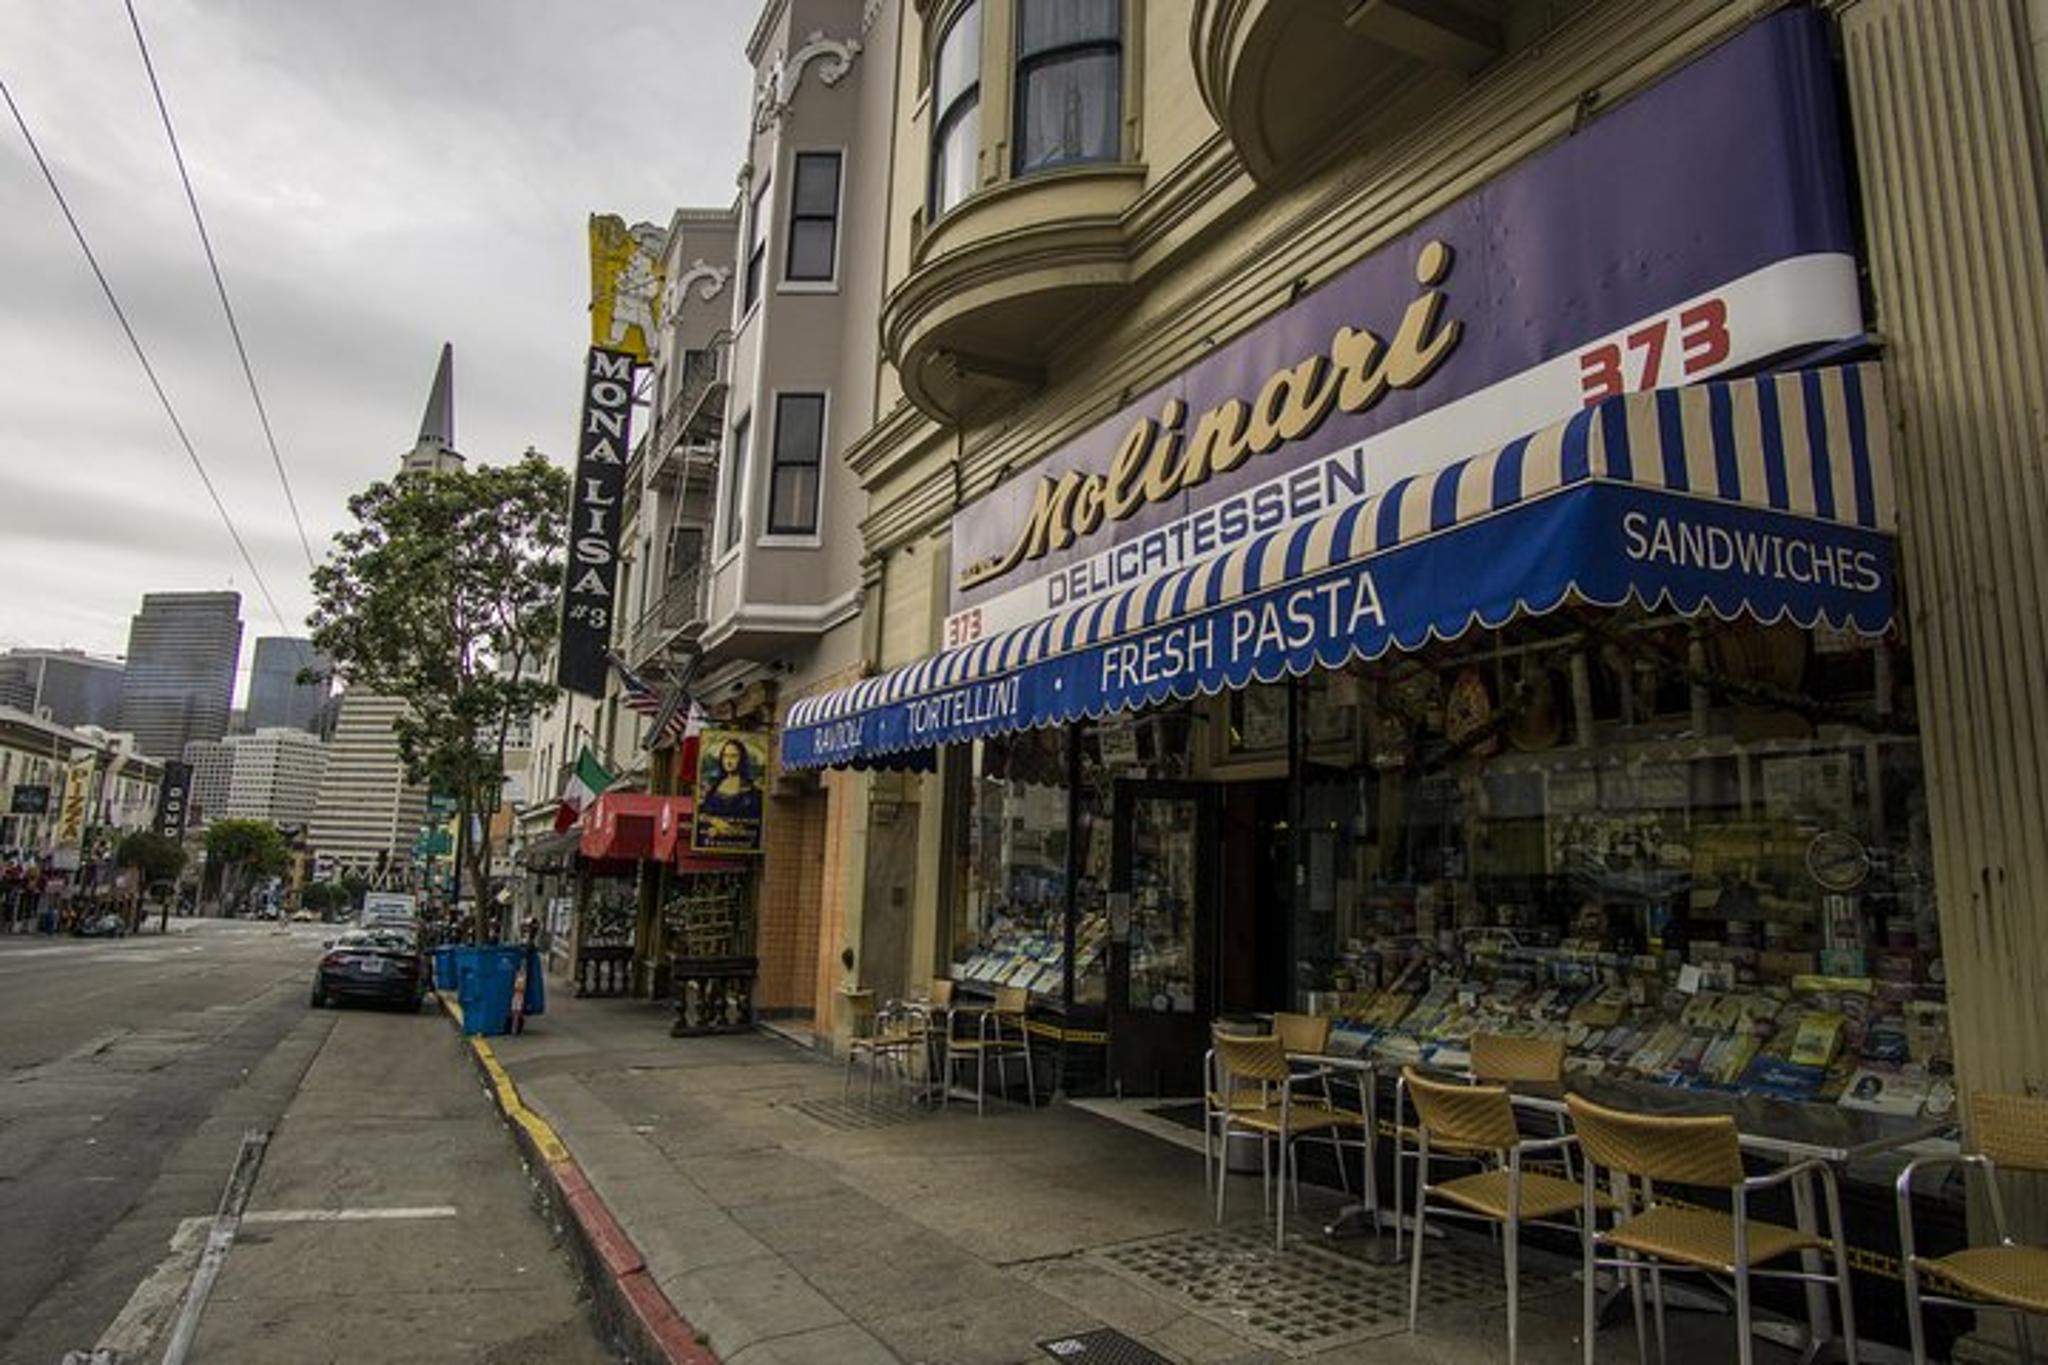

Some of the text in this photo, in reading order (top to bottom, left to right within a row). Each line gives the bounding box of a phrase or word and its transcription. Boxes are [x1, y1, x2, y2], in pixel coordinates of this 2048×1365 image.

[959, 240, 1464, 592] Molinari
[1580, 298, 1730, 408] 373
[568, 350, 633, 631] MONA LISA #3
[1047, 447, 1366, 609] DELICATESSEN
[1622, 511, 1881, 592] SANDWICHES
[906, 676, 1020, 733] TORTELLINI
[1100, 619, 1214, 693] FRESH
[1230, 570, 1387, 663] PASTA
[949, 608, 982, 647] 373
[62, 768, 88, 840] PIZZA
